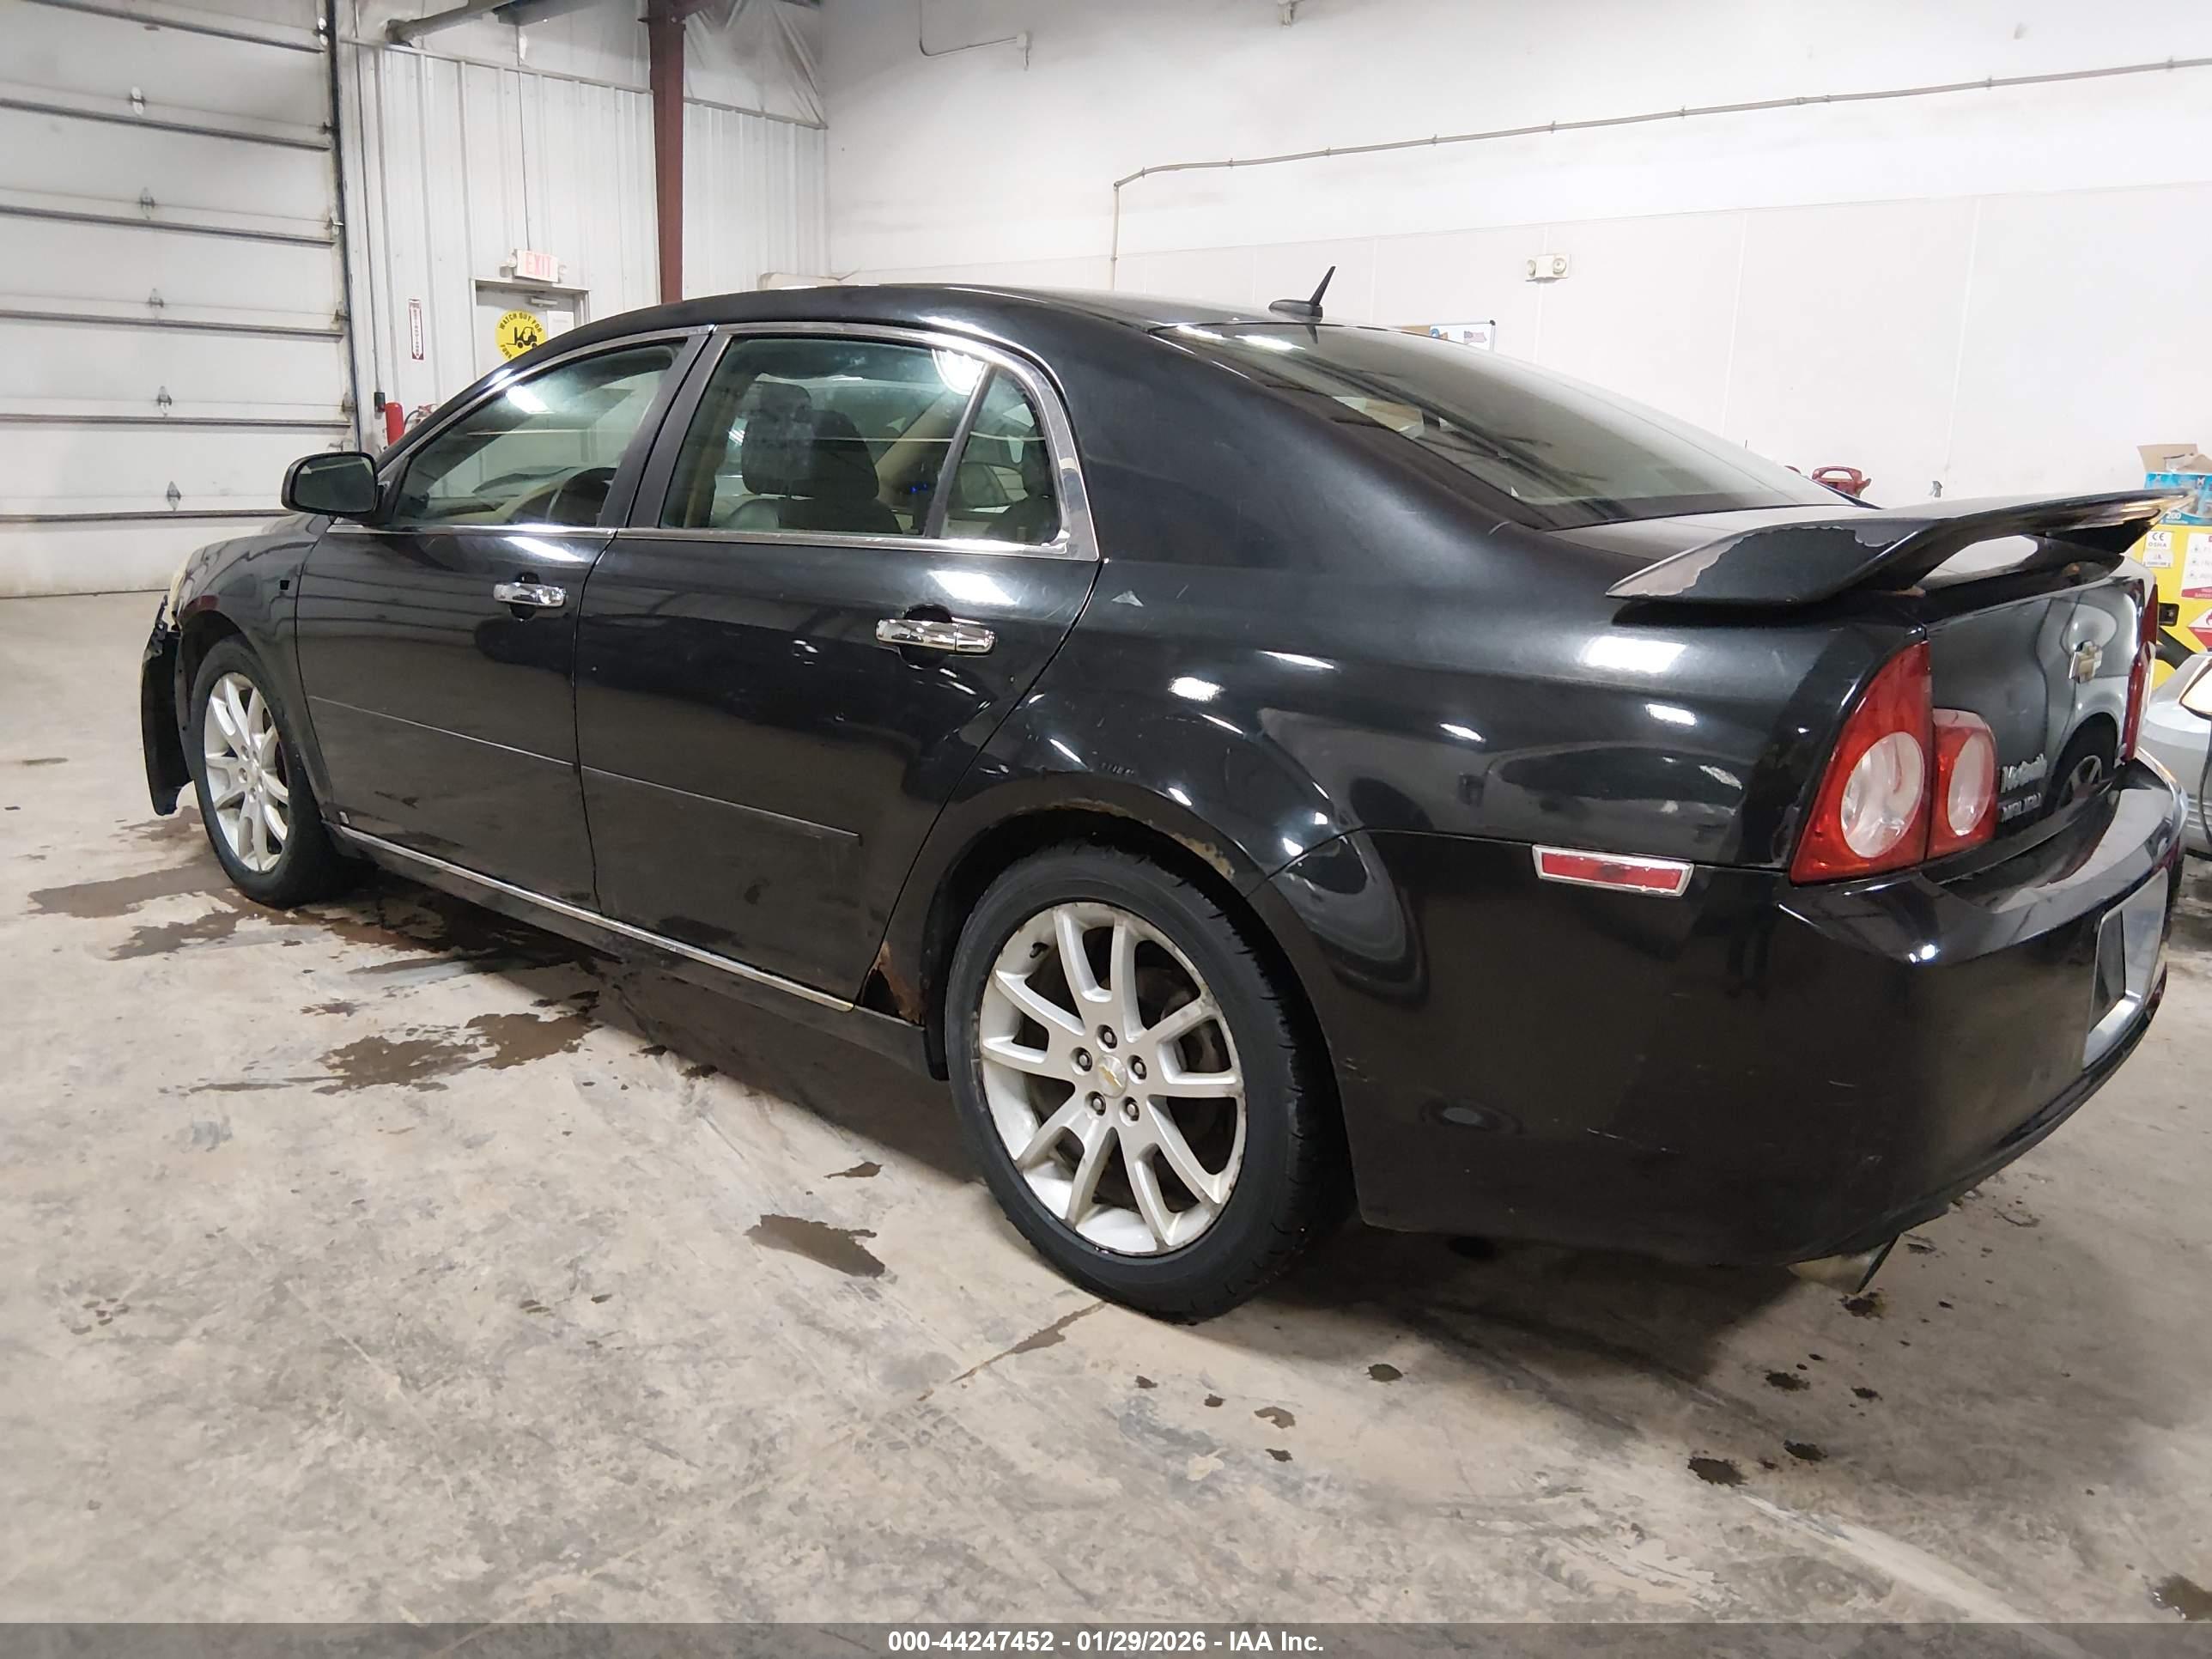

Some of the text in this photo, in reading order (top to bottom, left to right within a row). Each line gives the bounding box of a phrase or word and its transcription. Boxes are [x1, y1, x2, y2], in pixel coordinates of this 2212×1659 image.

[526, 252, 550, 277] EXIT
[499, 313, 517, 330] WATCH
[519, 312, 531, 322] OUT
[532, 319, 543, 333] FOR
